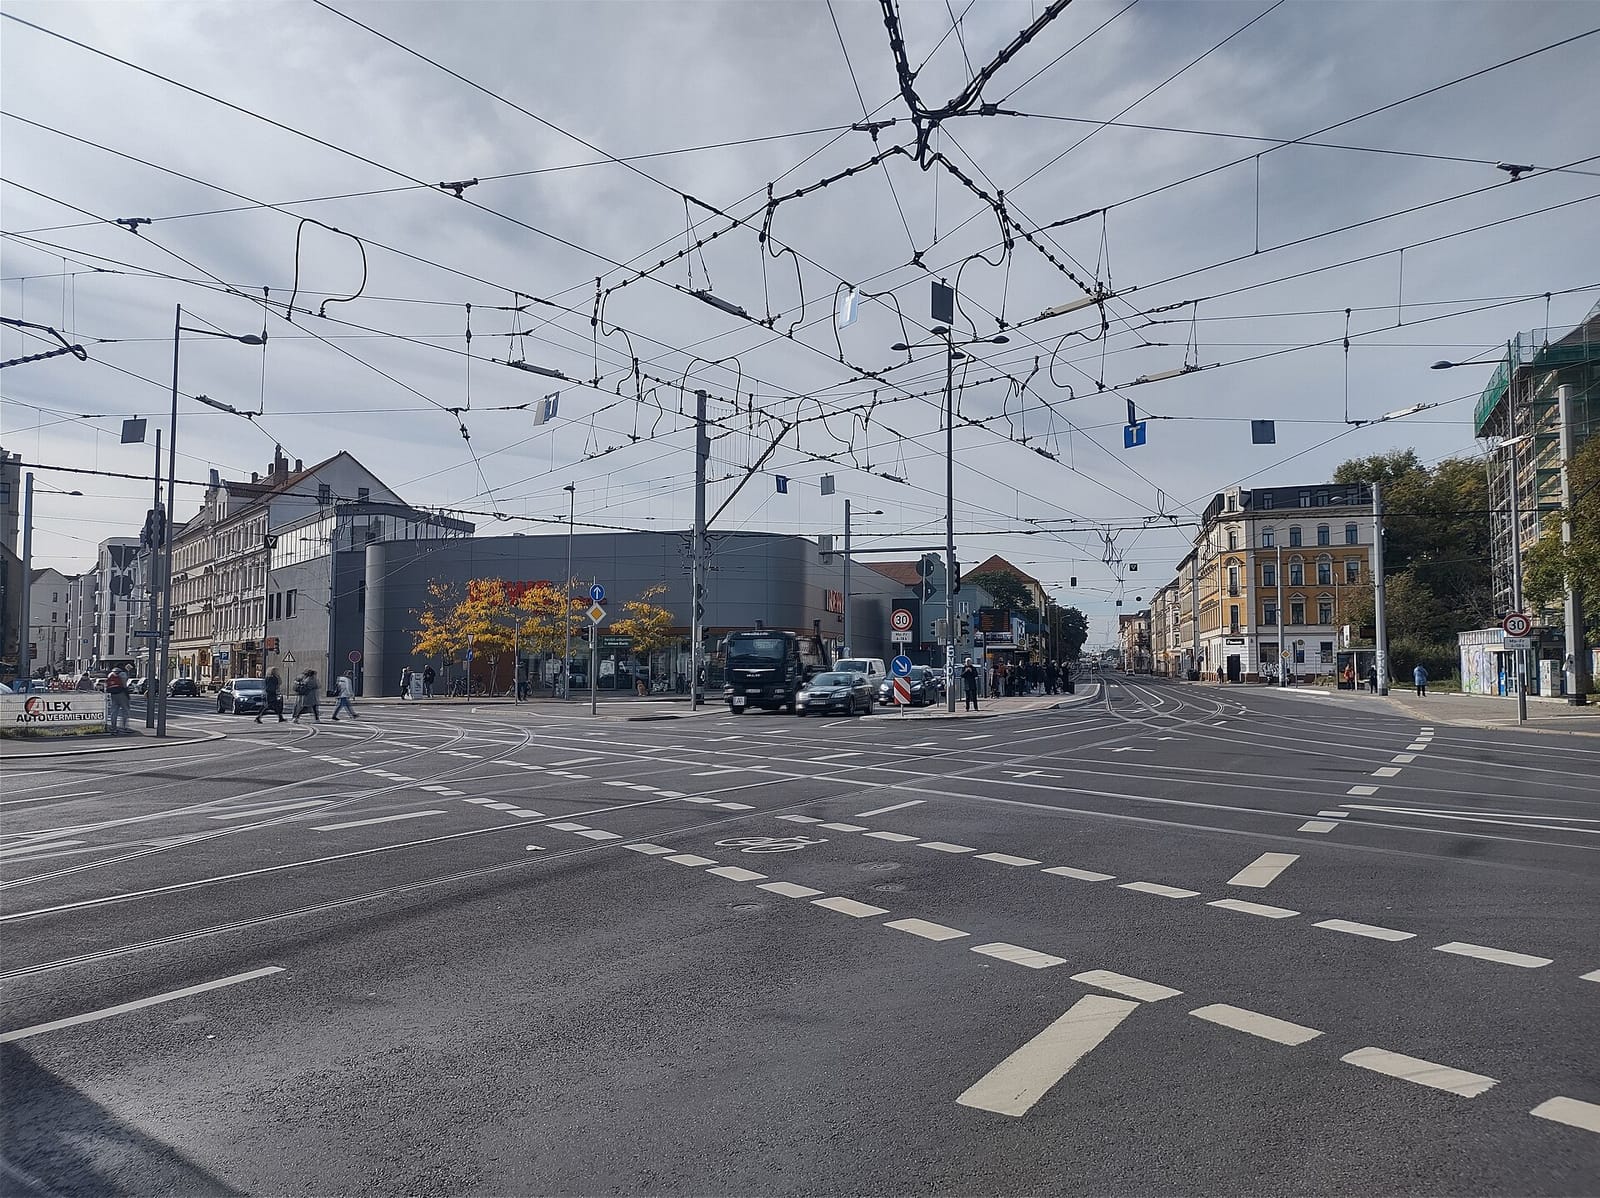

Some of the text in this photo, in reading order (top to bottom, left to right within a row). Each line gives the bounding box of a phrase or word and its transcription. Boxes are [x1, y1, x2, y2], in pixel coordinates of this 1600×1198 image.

[1129, 425, 1140, 444] T
[895, 615, 908, 625] 30
[1509, 620, 1525, 630] 30
